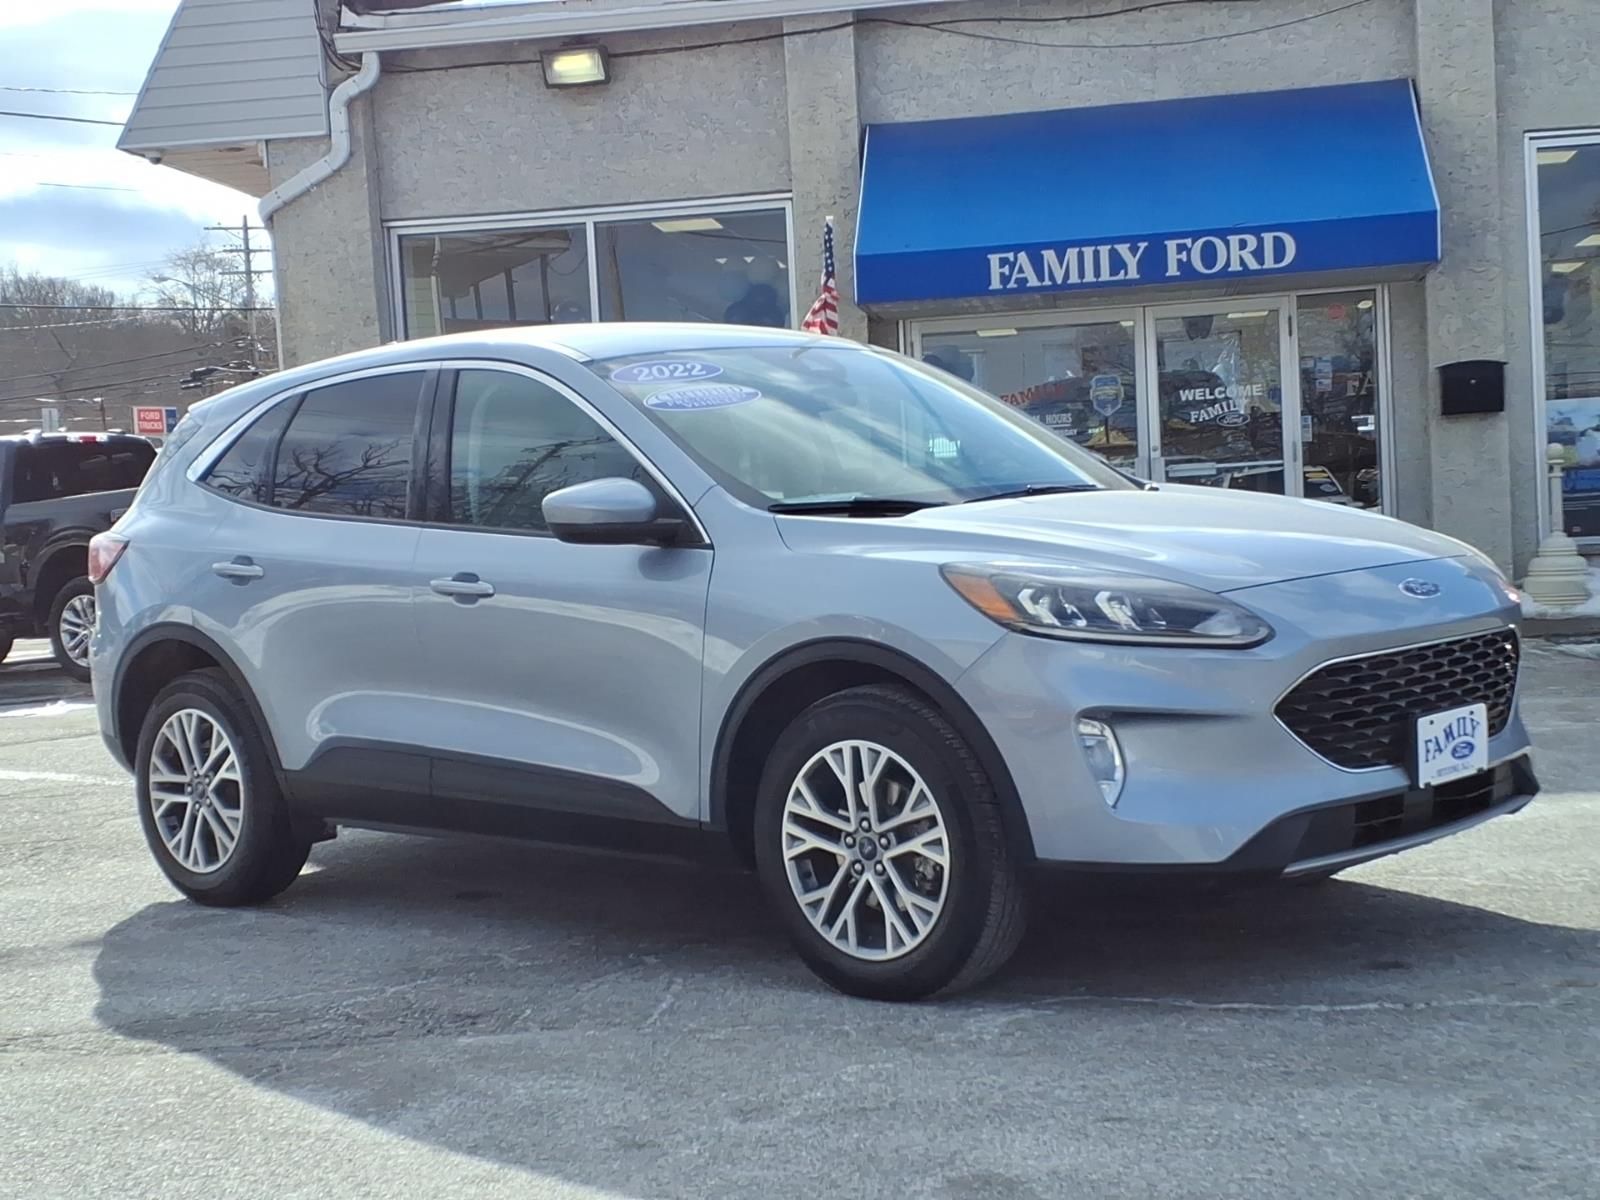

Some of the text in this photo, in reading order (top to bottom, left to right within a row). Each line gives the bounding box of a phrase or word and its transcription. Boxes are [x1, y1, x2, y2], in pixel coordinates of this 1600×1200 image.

[987, 231, 1297, 290] FAMILY FORD
[632, 363, 707, 381] 2022
[1179, 384, 1264, 401] WELCOME
[140, 411, 161, 420] FORD
[1046, 413, 1073, 425] HOURS
[139, 421, 163, 430] TRUCKS
[1425, 717, 1480, 763] FAMILY
